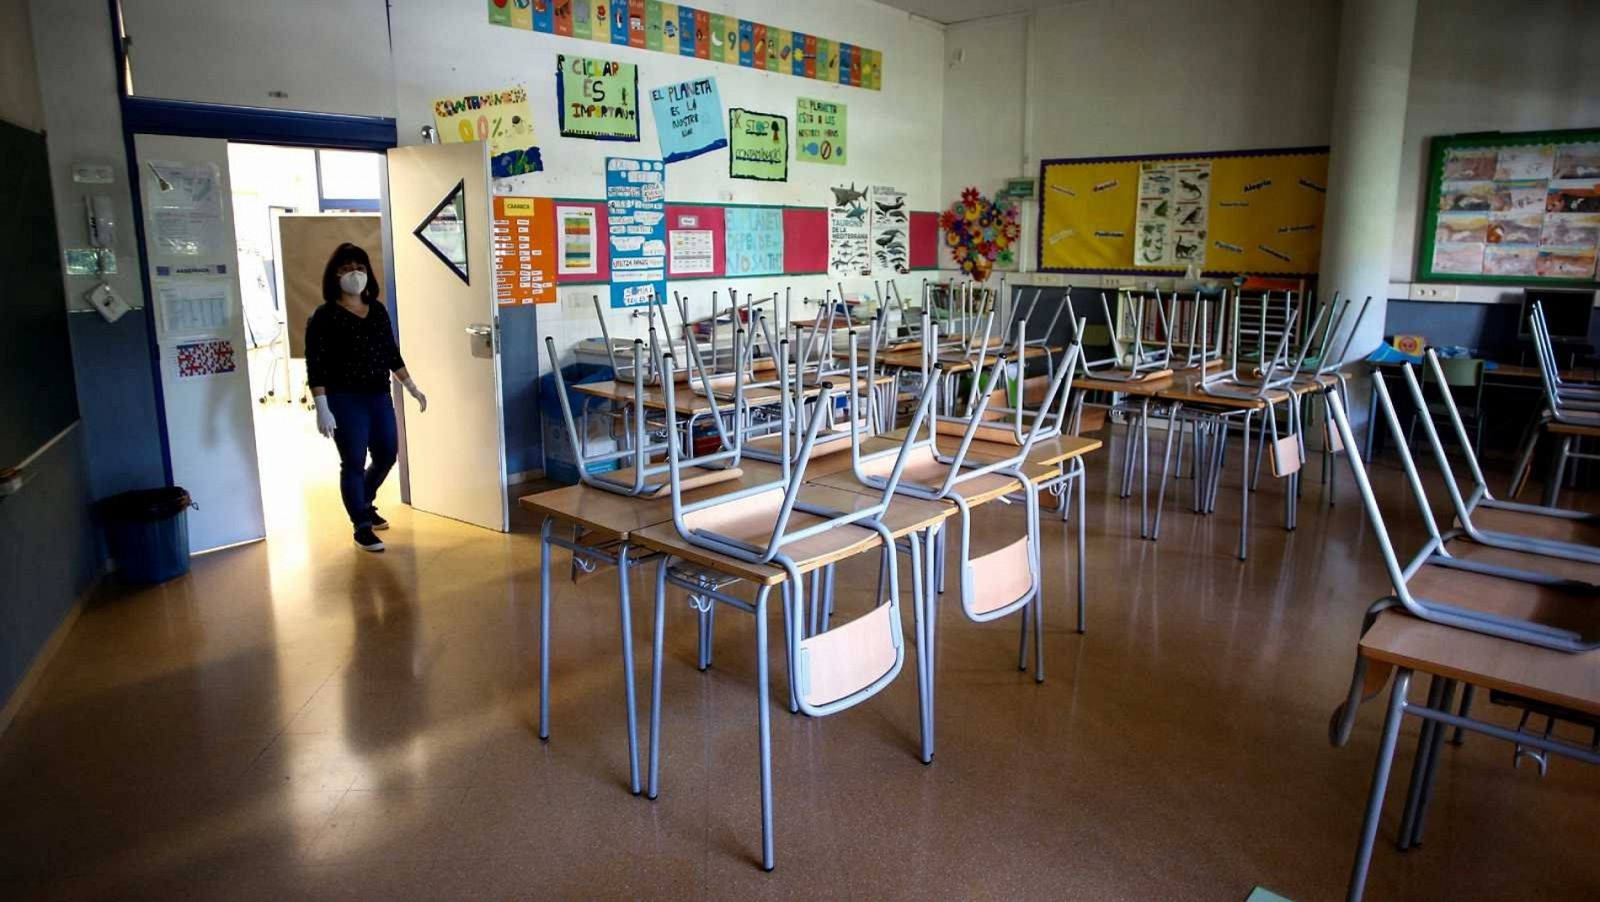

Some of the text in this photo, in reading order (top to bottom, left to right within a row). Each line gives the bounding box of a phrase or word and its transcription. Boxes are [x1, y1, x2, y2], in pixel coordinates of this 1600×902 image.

[652, 80, 712, 102] EL PLANETA
[571, 102, 635, 121] IMPORTANT
[686, 98, 697, 111] LA
[745, 120, 770, 133] STOP
